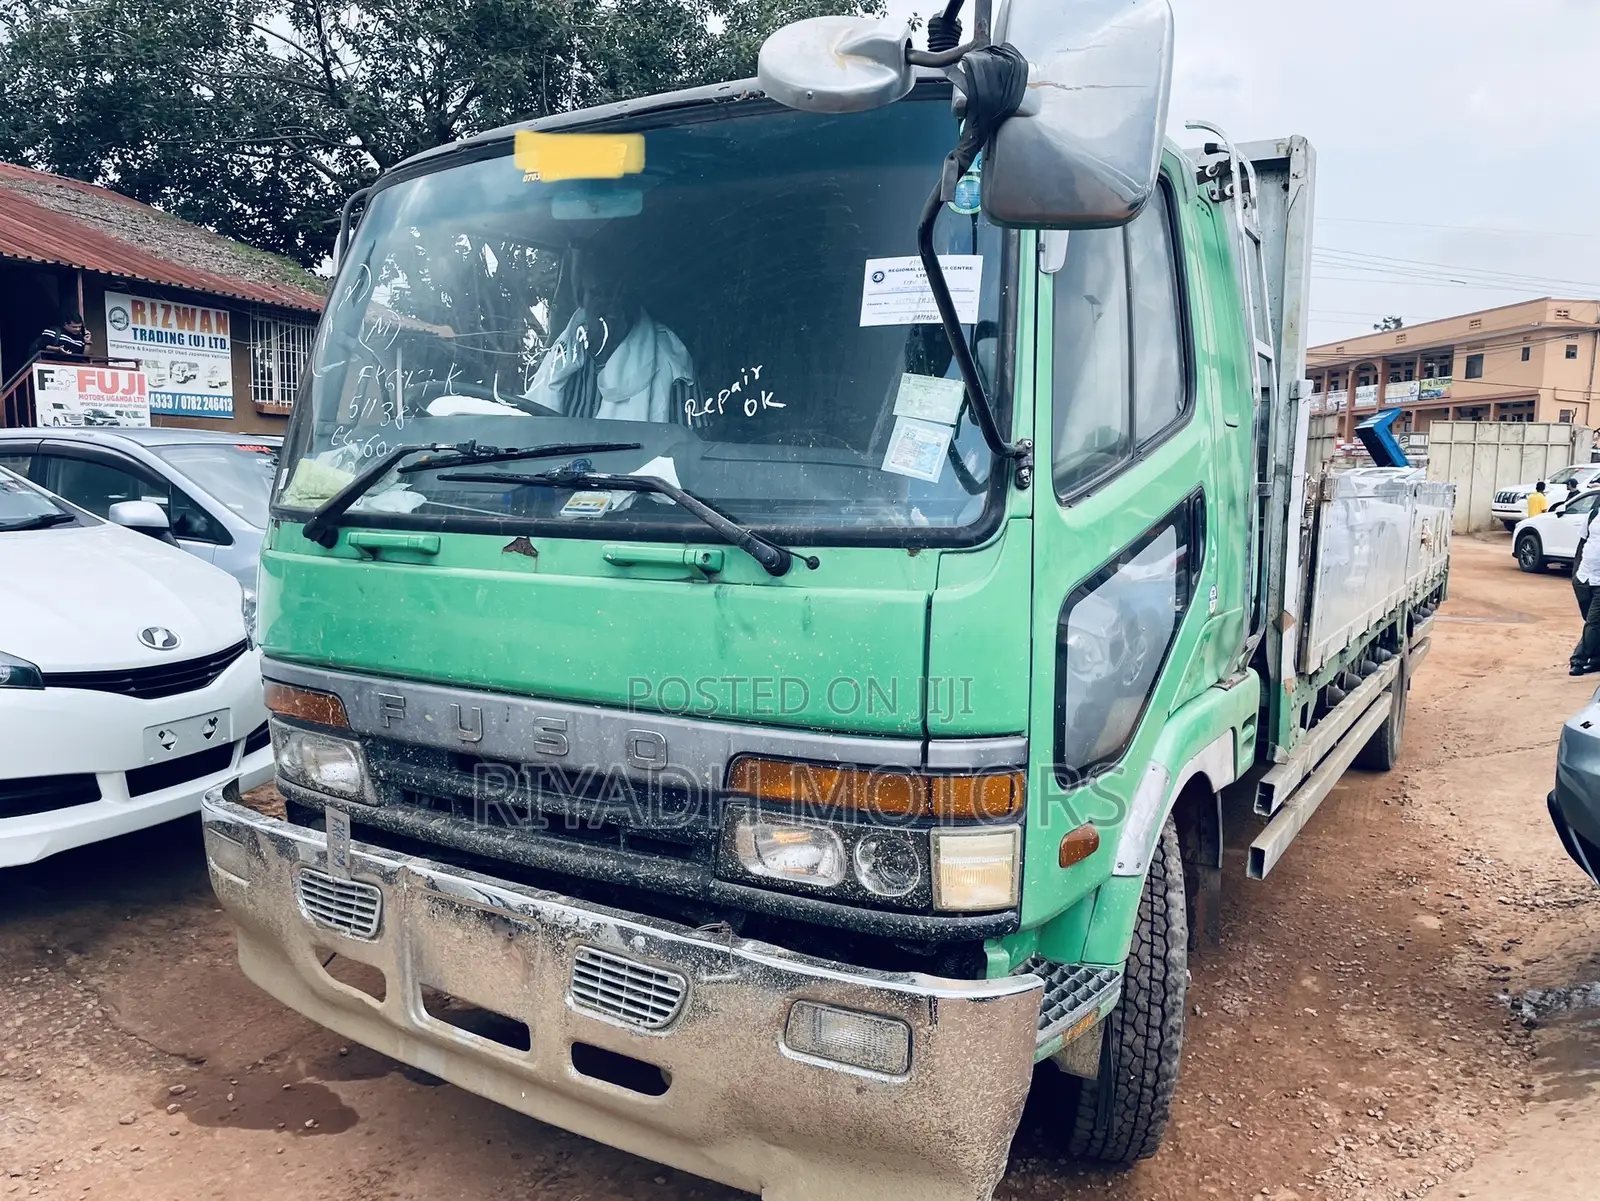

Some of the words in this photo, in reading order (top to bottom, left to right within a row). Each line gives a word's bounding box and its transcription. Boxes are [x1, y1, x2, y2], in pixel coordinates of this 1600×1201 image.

[130, 299, 229, 336] RIZWAN
[109, 343, 136, 351] Importers
[142, 346, 167, 355] Exporters
[188, 350, 210, 358] Japanese
[131, 327, 185, 346] TRADING
[209, 336, 230, 351] LTD.
[77, 369, 146, 396] FUJI
[685, 364, 763, 425] Repair
[78, 393, 105, 402] MOTORS
[106, 395, 132, 403] UGANDA
[180, 395, 202, 411] 0782
[203, 396, 233, 412] 246413
[743, 390, 787, 417] OK
[377, 692, 668, 771] FUSO
